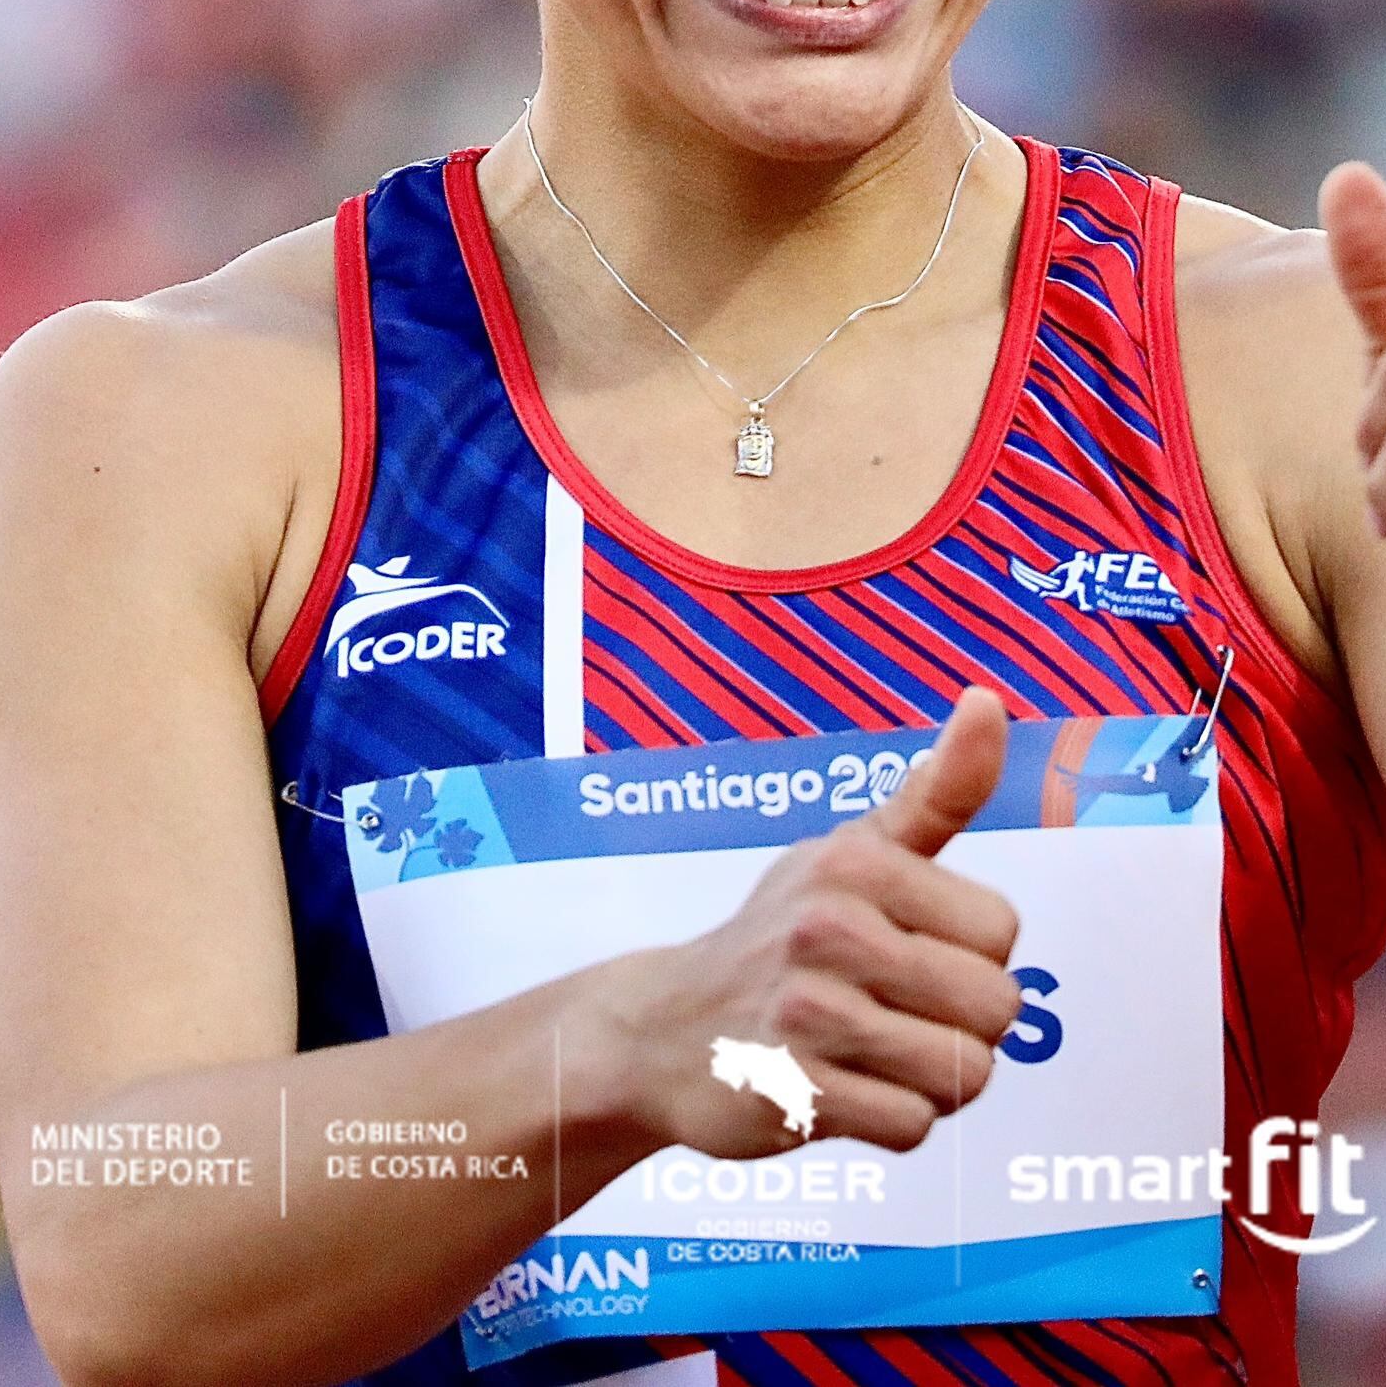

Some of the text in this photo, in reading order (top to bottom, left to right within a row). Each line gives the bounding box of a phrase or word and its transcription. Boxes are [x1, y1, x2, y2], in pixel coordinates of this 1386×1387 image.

[1111, 604, 1176, 623] Atletismo
[337, 621, 507, 678] ICODER
[579, 748, 935, 817] Santiago 20
